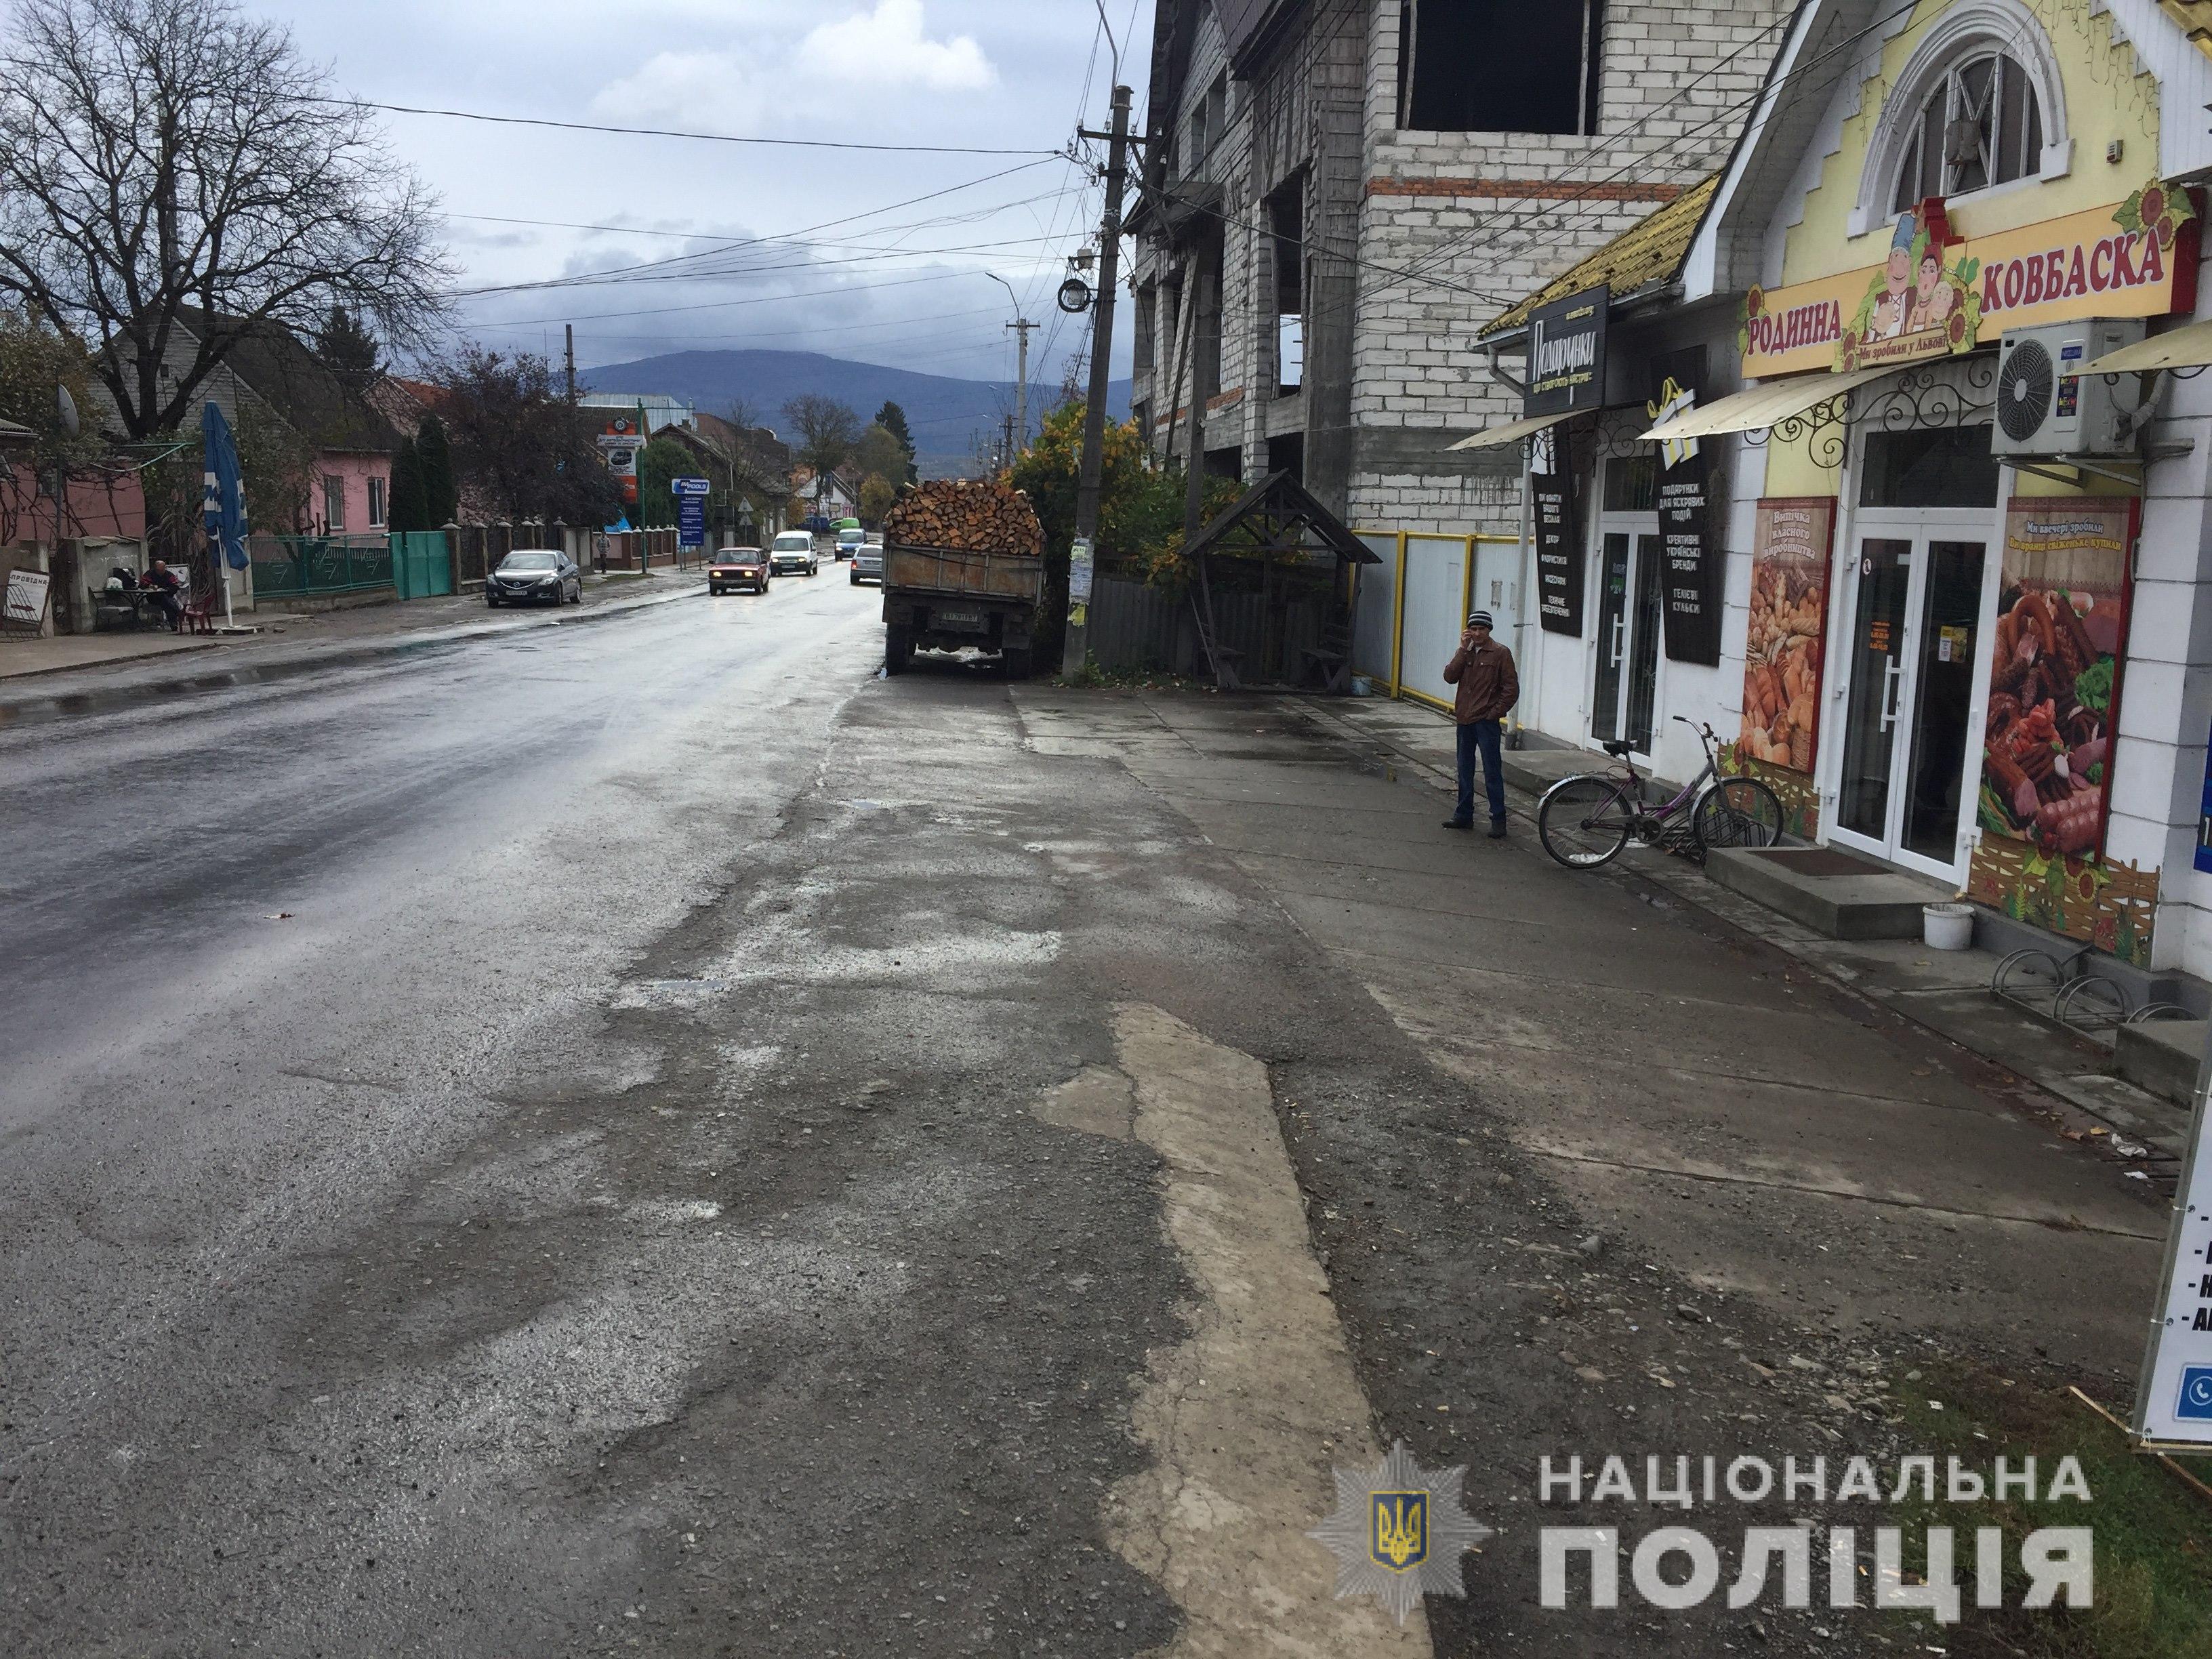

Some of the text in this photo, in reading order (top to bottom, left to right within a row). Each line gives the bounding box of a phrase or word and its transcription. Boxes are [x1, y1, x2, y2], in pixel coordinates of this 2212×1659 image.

[1980, 228, 2165, 313] КОВБАСКА
[1747, 299, 1842, 356] РОДИННА
[1860, 337, 1946, 361] Ми зробили у Львові
[1662, 483, 1699, 495] ПОДАРУНКИ
[1659, 497, 1705, 510] ДЛЯ ЯСКРАВИХ
[1672, 508, 1692, 522] ПОДІЙ
[1774, 510, 1810, 524] Випічка
[2026, 521, 2038, 534] Ми
[2070, 518, 2104, 535] зробили
[1772, 527, 1810, 540] власного
[1666, 546, 1701, 558] УКРАЇНСЬКІ
[1763, 538, 1816, 560] виробництва
[1672, 559, 1697, 572] БРЕНДИ
[11, 574, 47, 585] ПРОВІДНА
[1673, 602, 1701, 614] КУЛЬКИ
